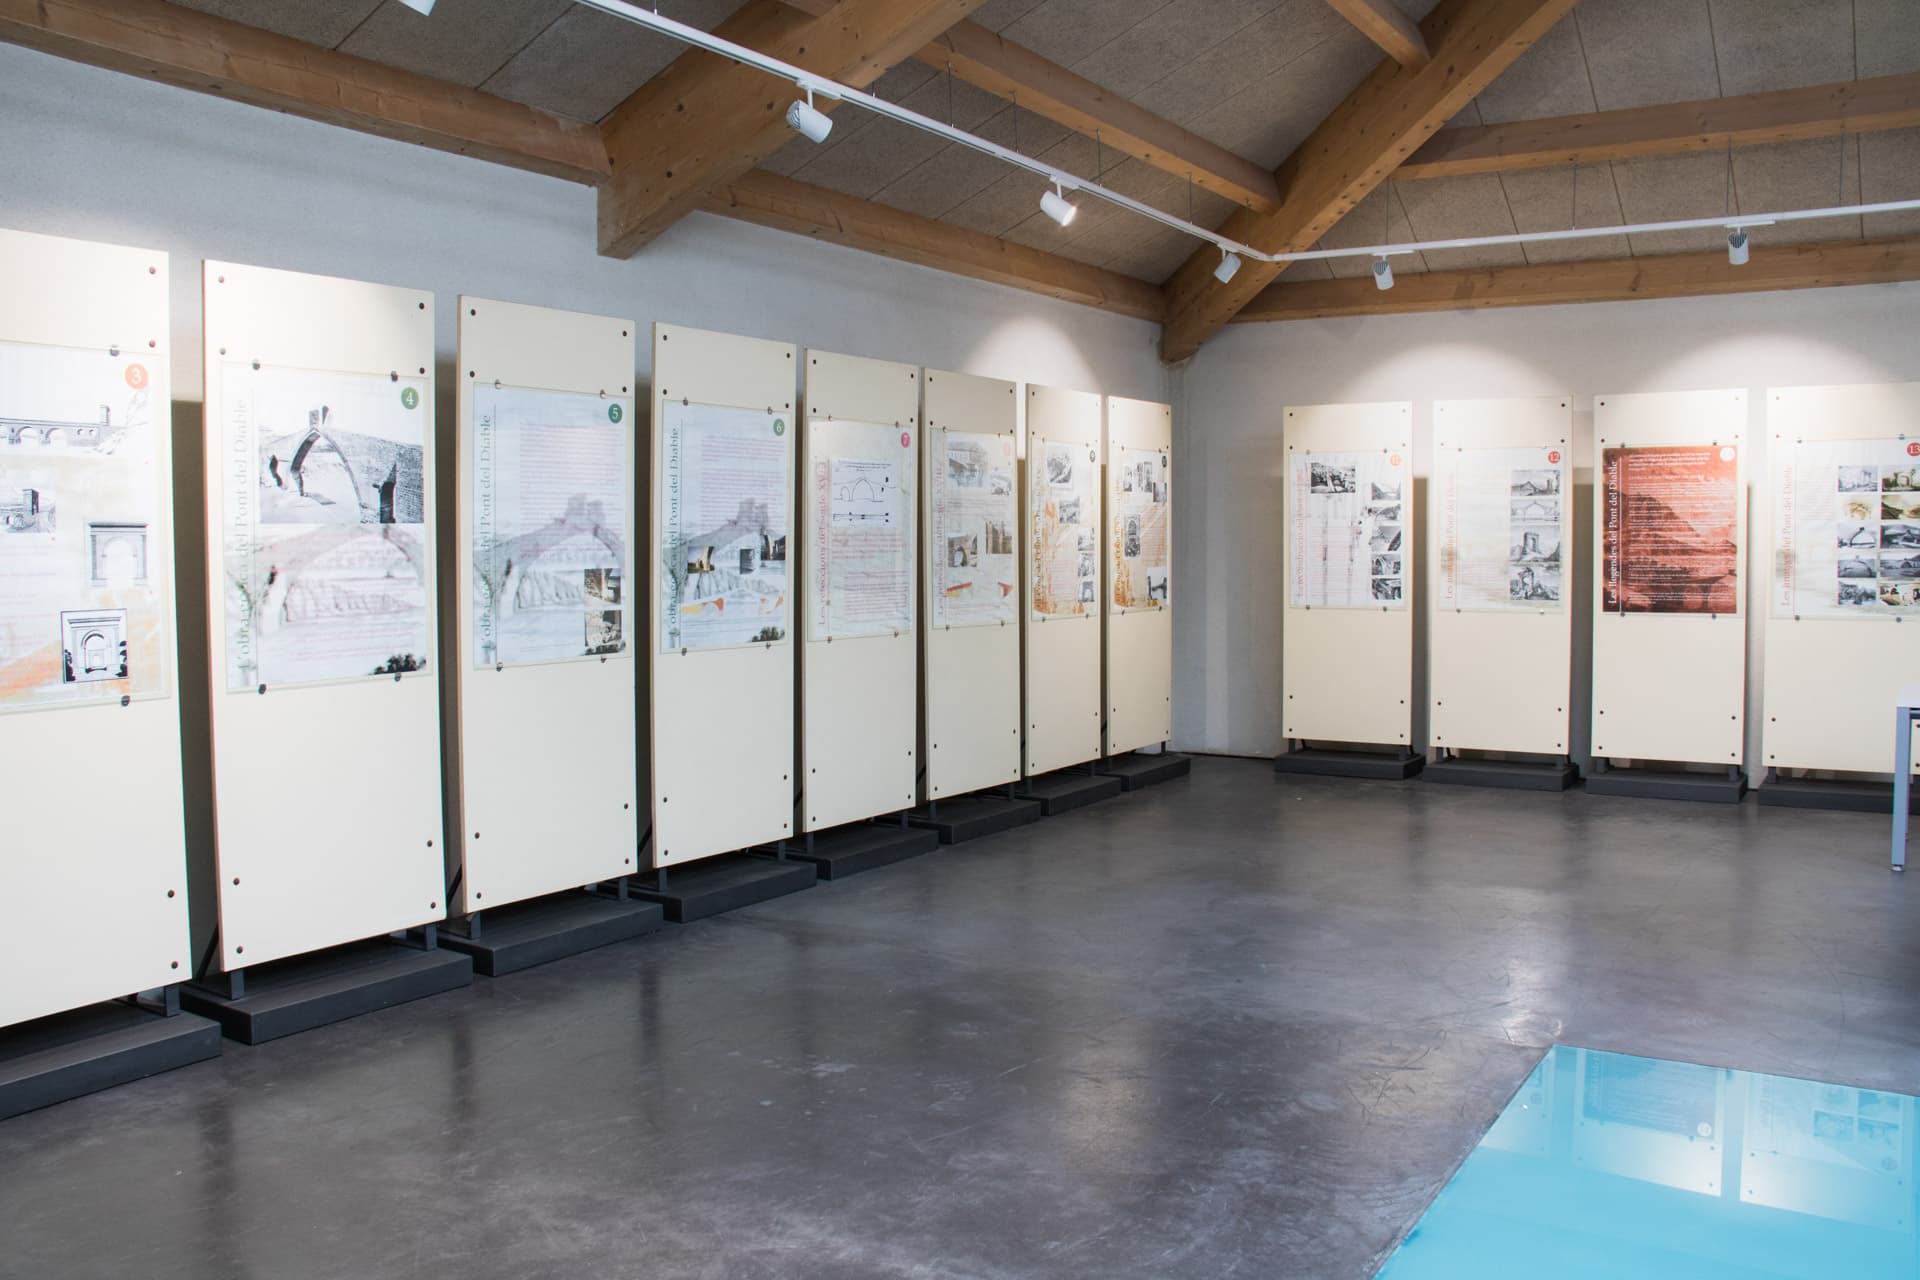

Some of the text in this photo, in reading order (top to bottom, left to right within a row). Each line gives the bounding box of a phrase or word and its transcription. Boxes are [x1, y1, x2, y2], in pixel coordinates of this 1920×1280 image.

[132, 367, 142, 385] 3
[405, 391, 415, 405] 4
[612, 407, 619, 420] 5
[232, 399, 248, 454] Diable
[776, 422, 782, 433] 6
[479, 415, 491, 462] Diable
[667, 427, 678, 470] Diable
[232, 459, 248, 485] del
[479, 467, 491, 489] del
[667, 474, 678, 495] del
[233, 489, 248, 528] Pont
[480, 493, 491, 526] Pont
[668, 498, 679, 526] Pont
[1607, 461, 1620, 604] Les llegendes del Pont del Diable
[1782, 513, 1792, 535] Pont
[233, 533, 249, 560] del
[479, 530, 491, 551] del
[668, 529, 679, 550] del
[1780, 590, 1790, 606] Les
[817, 606, 826, 625] Les
